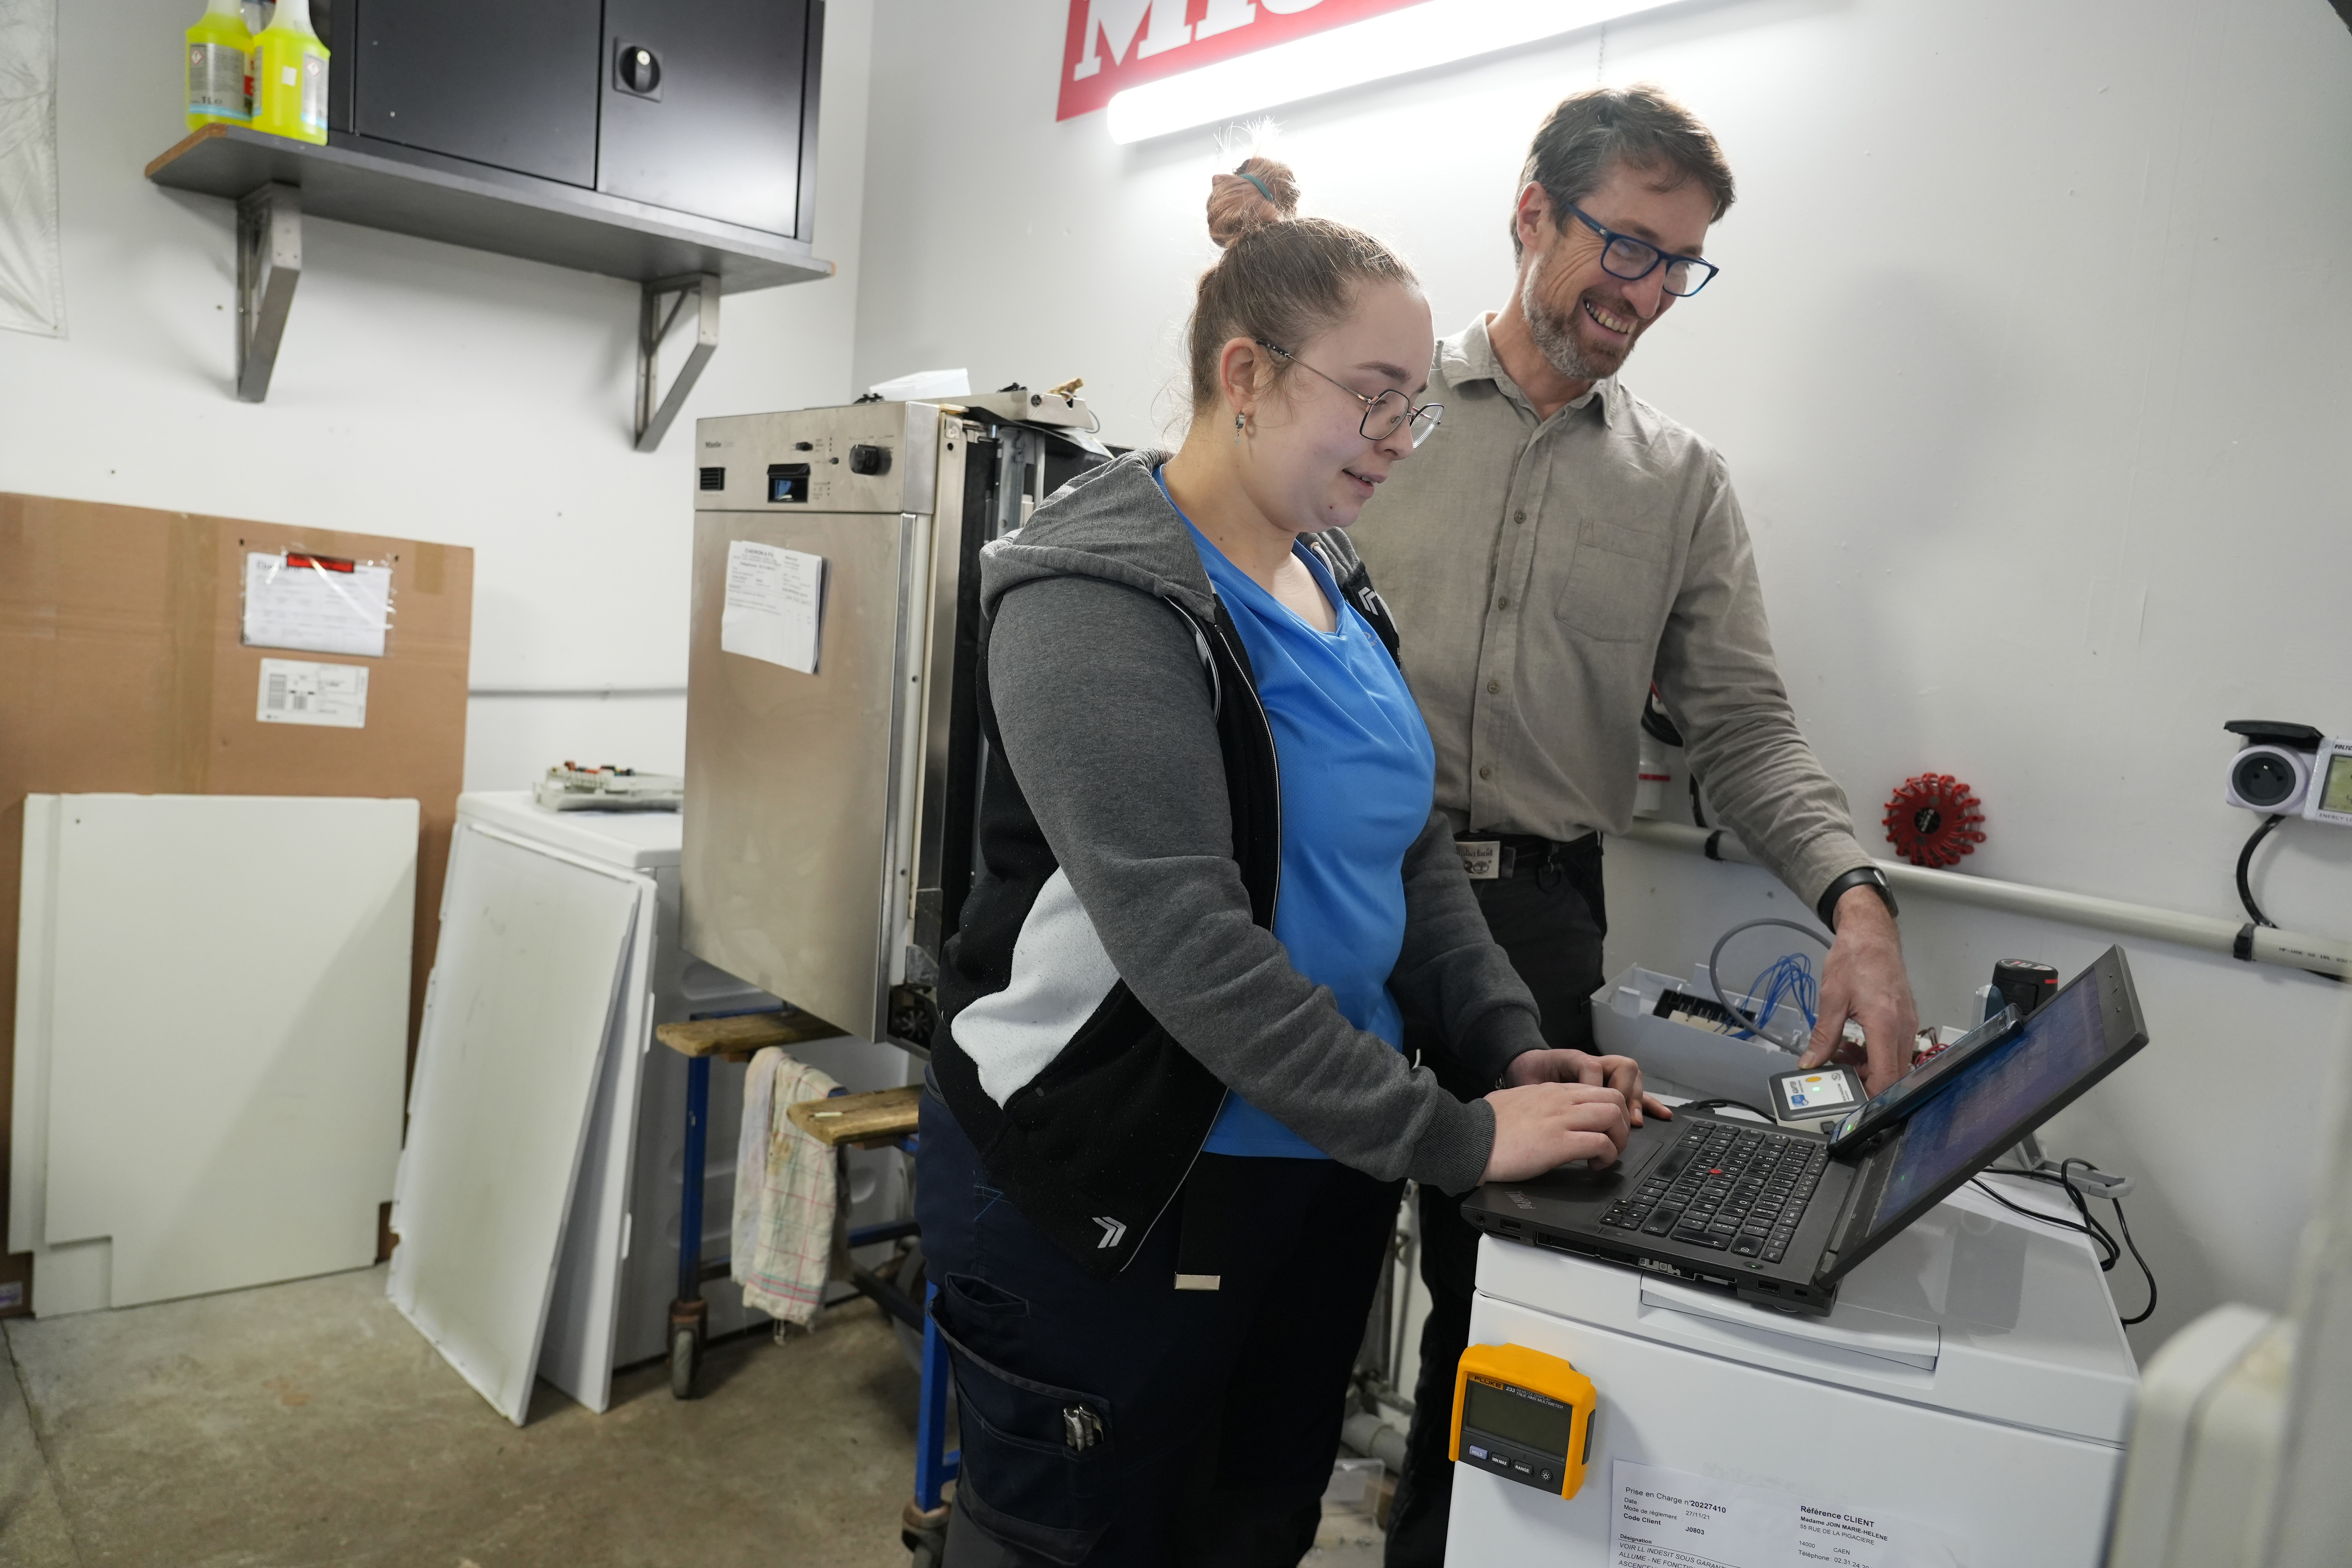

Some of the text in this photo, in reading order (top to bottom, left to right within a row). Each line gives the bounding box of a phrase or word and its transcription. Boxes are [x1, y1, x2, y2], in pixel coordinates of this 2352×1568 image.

[1505, 1190, 1536, 1209] ThinkPad
[1474, 1376, 1501, 1388] FLUKE
[1534, 1393, 1551, 1401] DISPLAY
[1537, 1398, 1563, 1409] MULTIMETER
[1515, 1465, 1530, 1473] RANGE
[1625, 1487, 1643, 1496] Prise
[1657, 1493, 1682, 1504] Charge
[1624, 1513, 1640, 1522] Code
[1649, 1510, 1677, 1520] règlement
[1686, 1510, 1710, 1520] 27/11/21
[1801, 1506, 1875, 1527] Référence CLIENT
[1801, 1516, 1825, 1526] Madame
[1842, 1525, 1888, 1541] MARIE-HELENE
[1620, 1533, 1652, 1544] Désignation
[1842, 1532, 1875, 1545] PIGACIERE
[1619, 1552, 1646, 1561] ALLUME
[1647, 1548, 1675, 1558] INDESIT
[1675, 1554, 1695, 1563] SOUS
